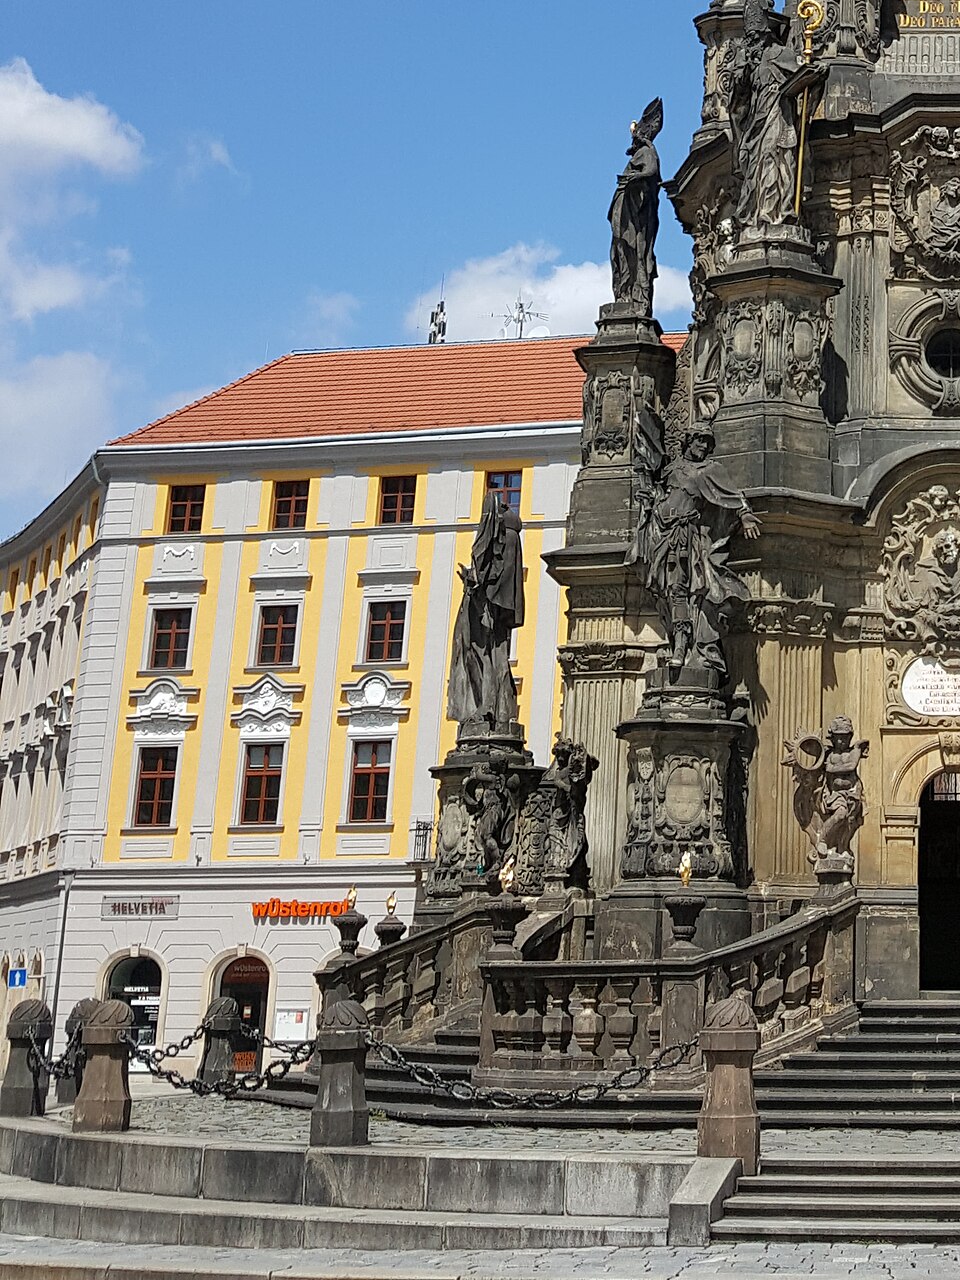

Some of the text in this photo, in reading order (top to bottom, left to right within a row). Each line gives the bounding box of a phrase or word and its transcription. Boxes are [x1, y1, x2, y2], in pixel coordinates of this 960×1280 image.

[919, 0, 944, 14] DEO
[900, 13, 926, 28] DEO
[112, 902, 166, 915] HELVETIA
